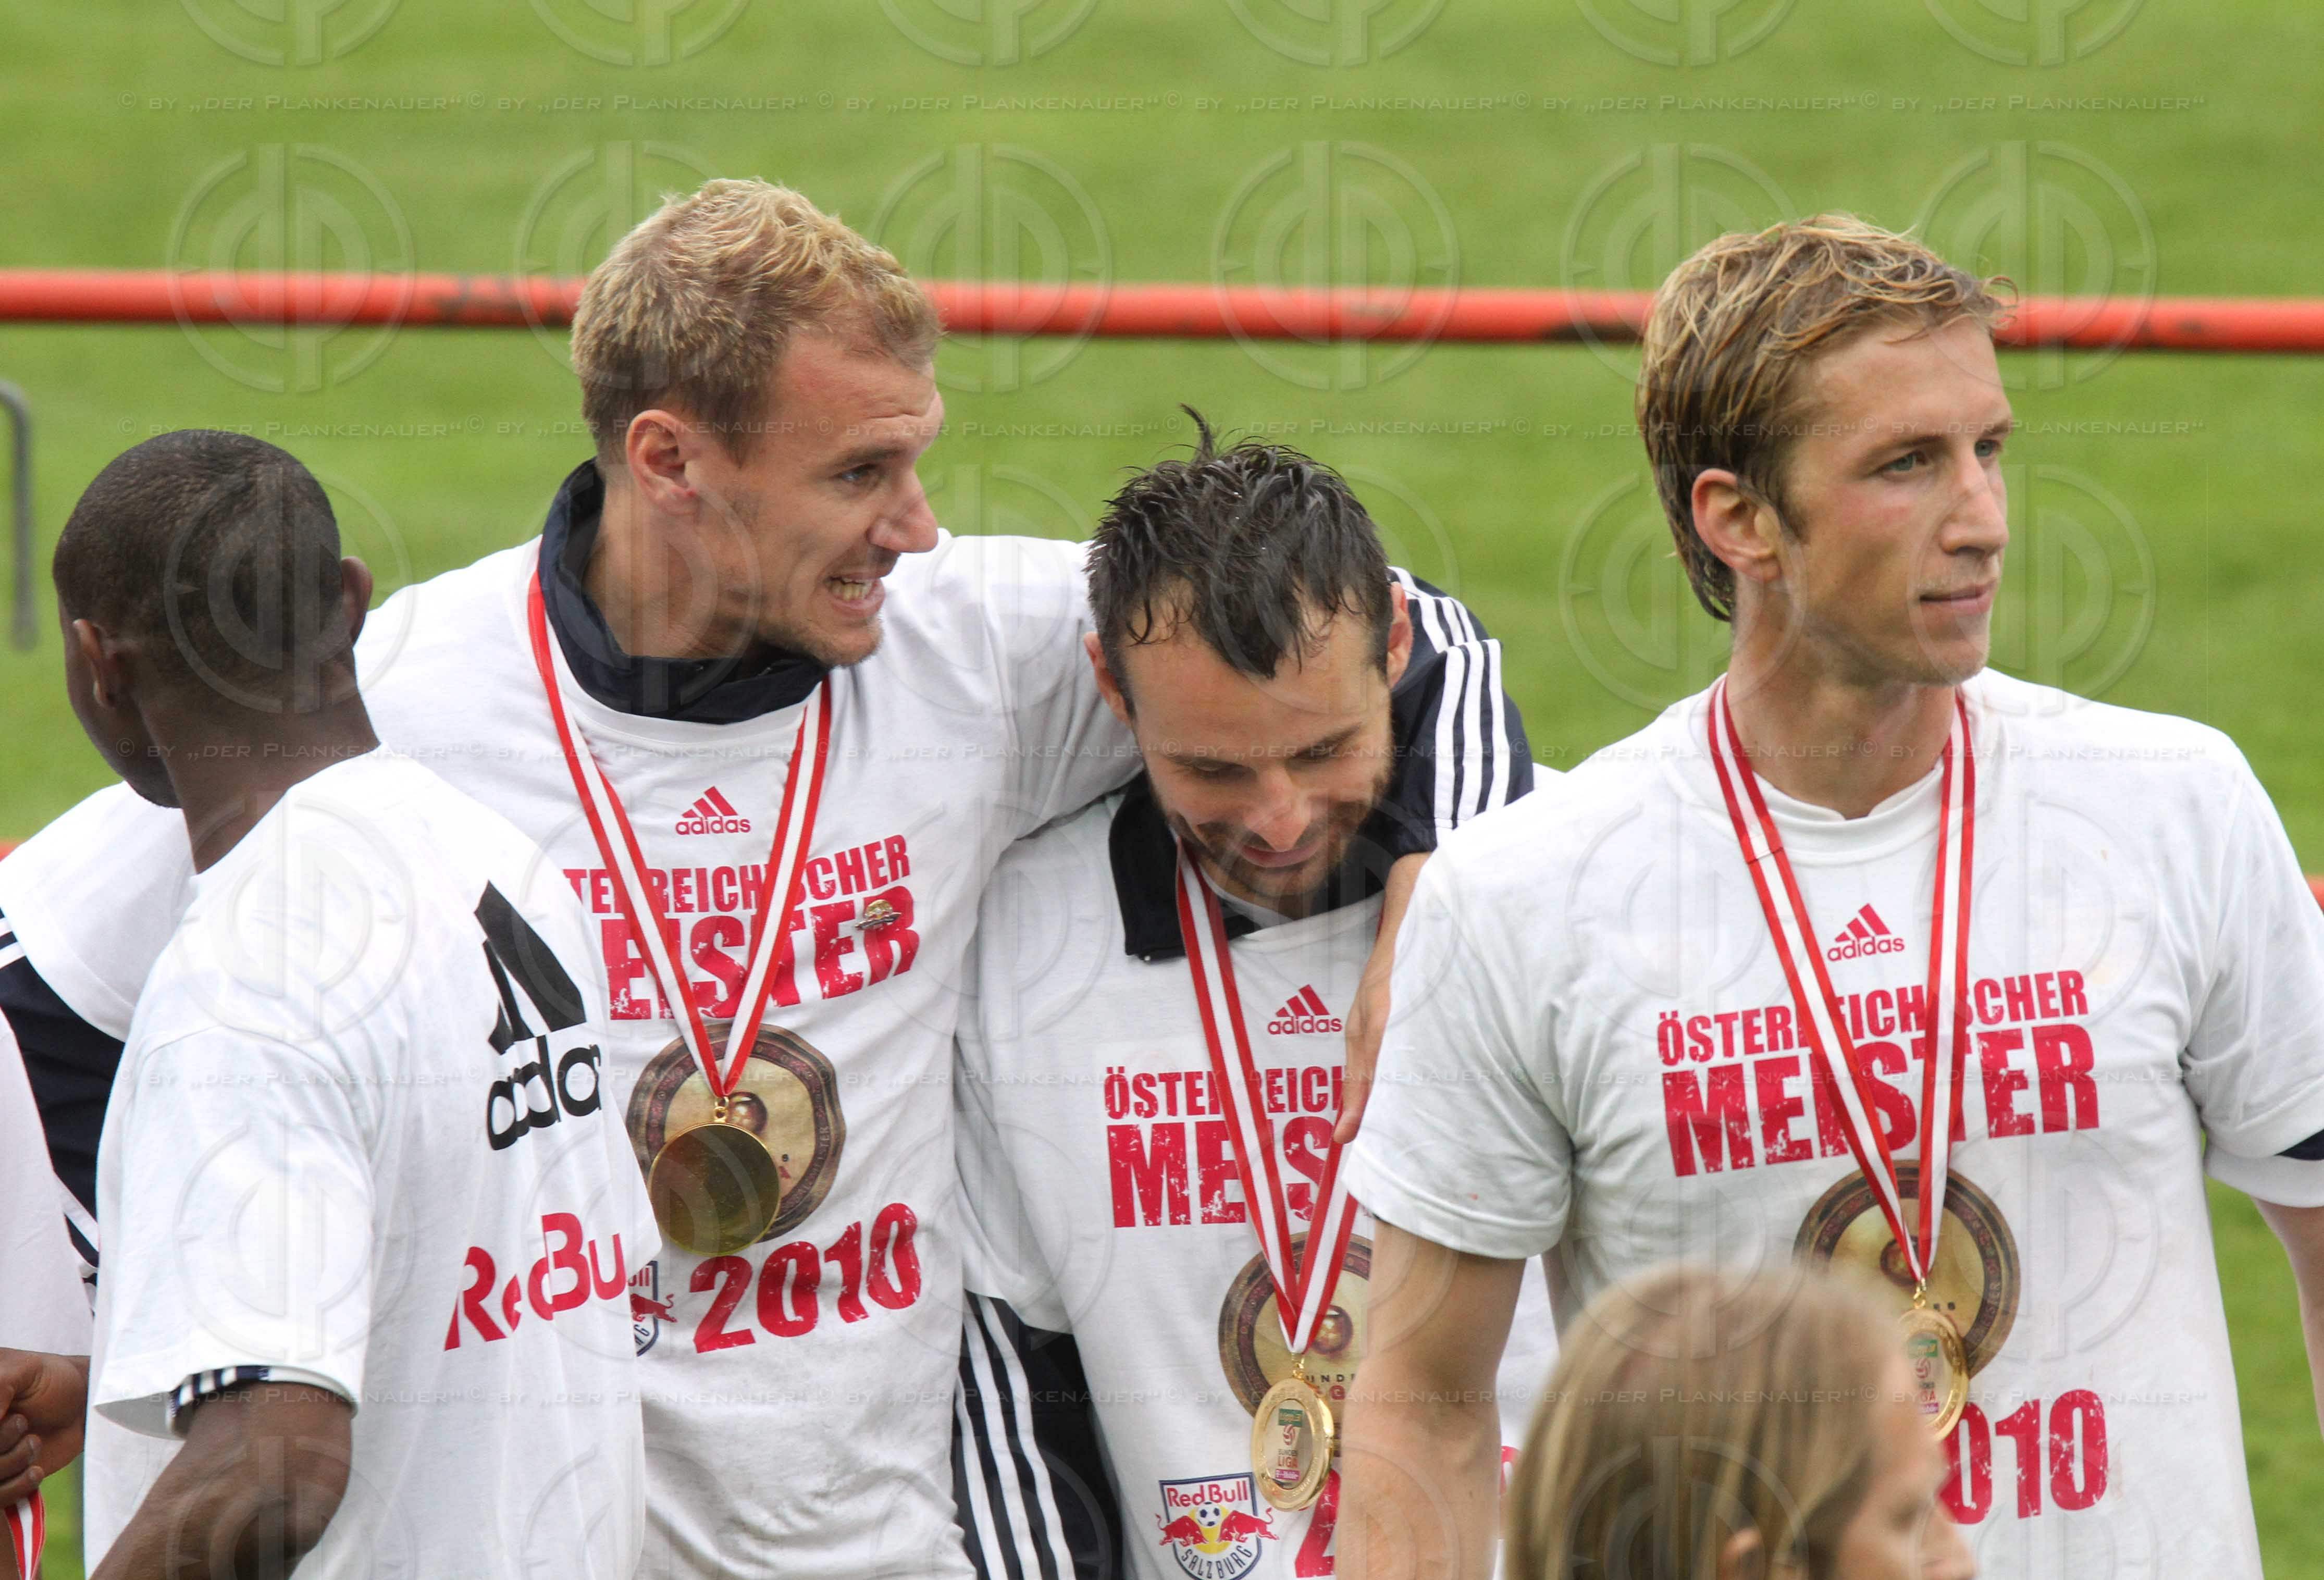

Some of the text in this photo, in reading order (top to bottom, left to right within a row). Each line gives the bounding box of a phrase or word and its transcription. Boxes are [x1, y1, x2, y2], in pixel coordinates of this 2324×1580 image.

[676, 816, 751, 835] adidas
[1827, 934, 1905, 962] adidas
[1268, 1015, 1343, 1035] adidas
[689, 1203, 921, 1353] 2010
[1166, 1480, 1248, 1507] Red Bull
[1181, 1545, 1253, 1579] SALZBURG
